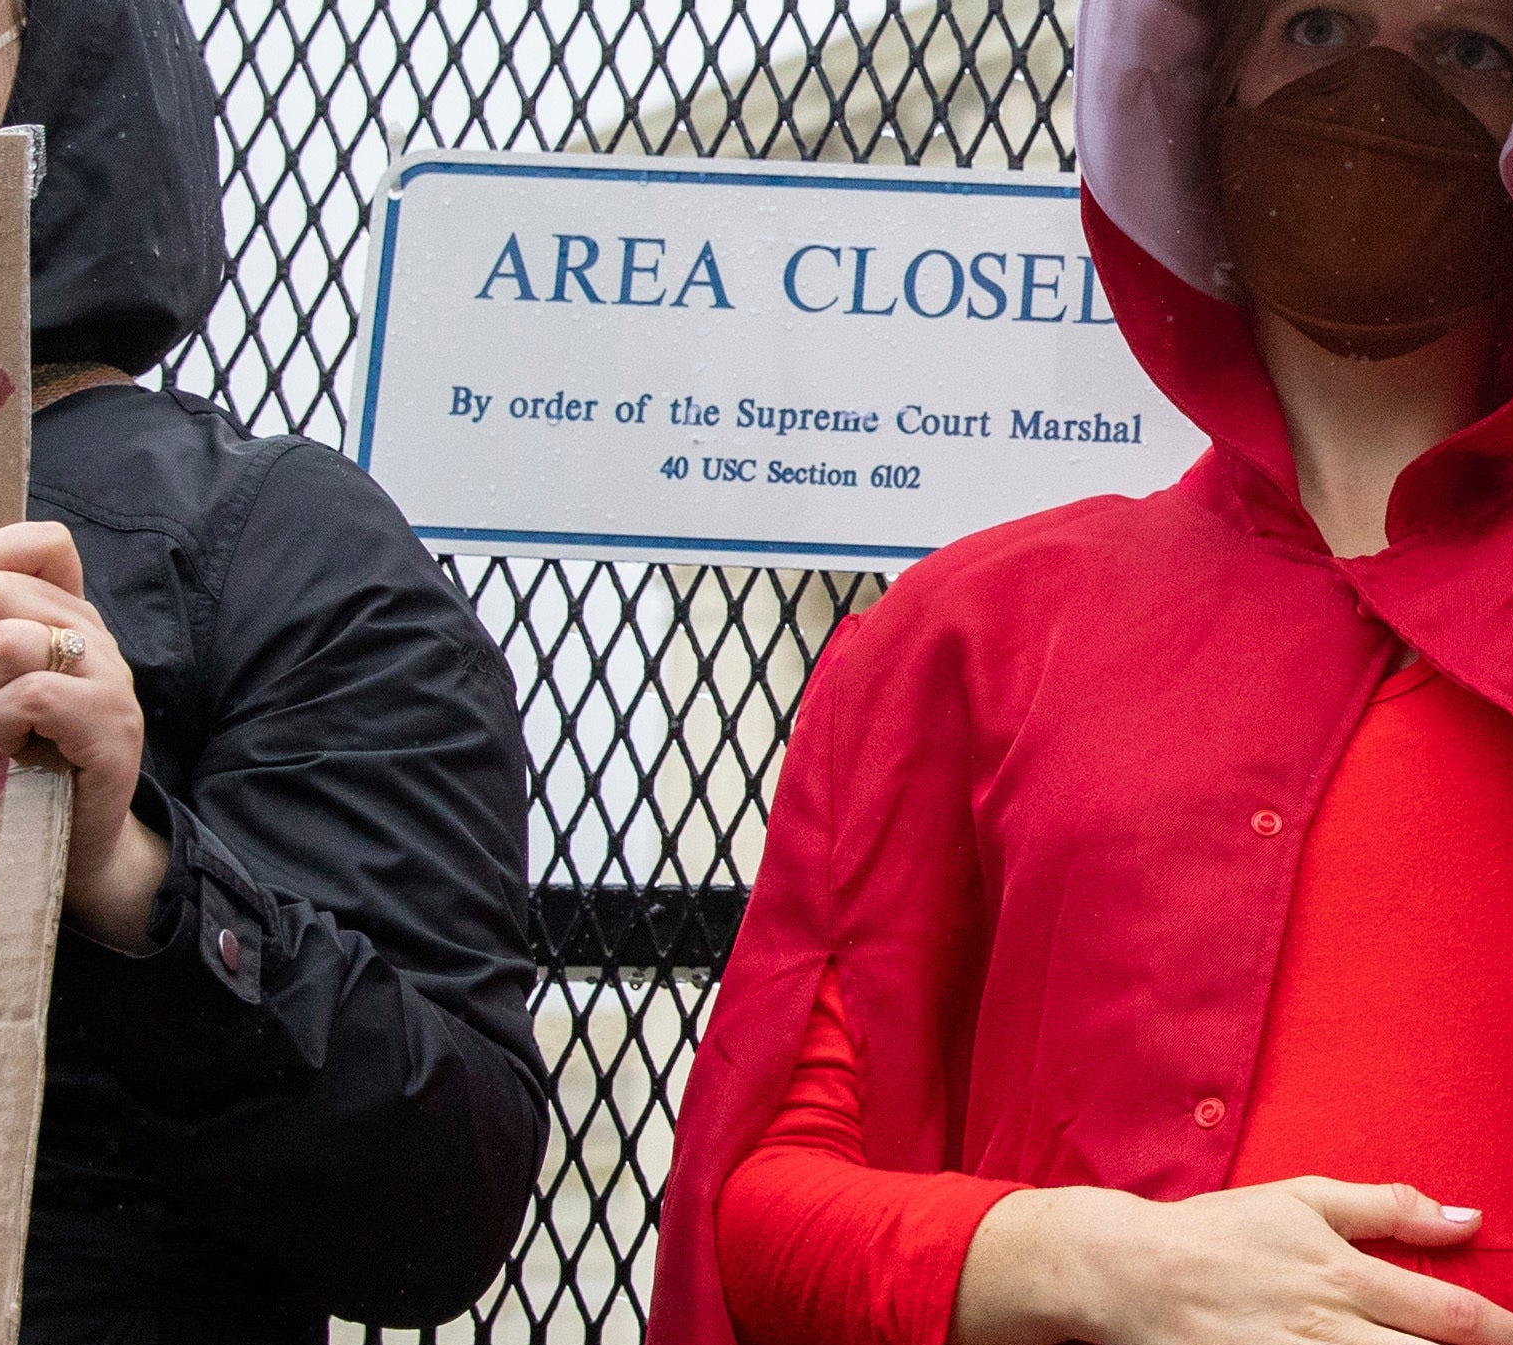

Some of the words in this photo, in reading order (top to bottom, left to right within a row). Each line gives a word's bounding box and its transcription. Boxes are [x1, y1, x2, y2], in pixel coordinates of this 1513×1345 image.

[473, 231, 736, 310] AREA
[449, 386, 493, 423] By
[509, 391, 599, 422] order
[615, 394, 653, 423] of
[670, 396, 720, 426] the
[736, 399, 880, 436] Supreme
[895, 405, 992, 438] Court
[1008, 410, 1143, 444] Marshal
[660, 456, 689, 479] 40
[702, 458, 757, 482] USC
[767, 461, 858, 487] Section
[870, 465, 921, 489] 6102
